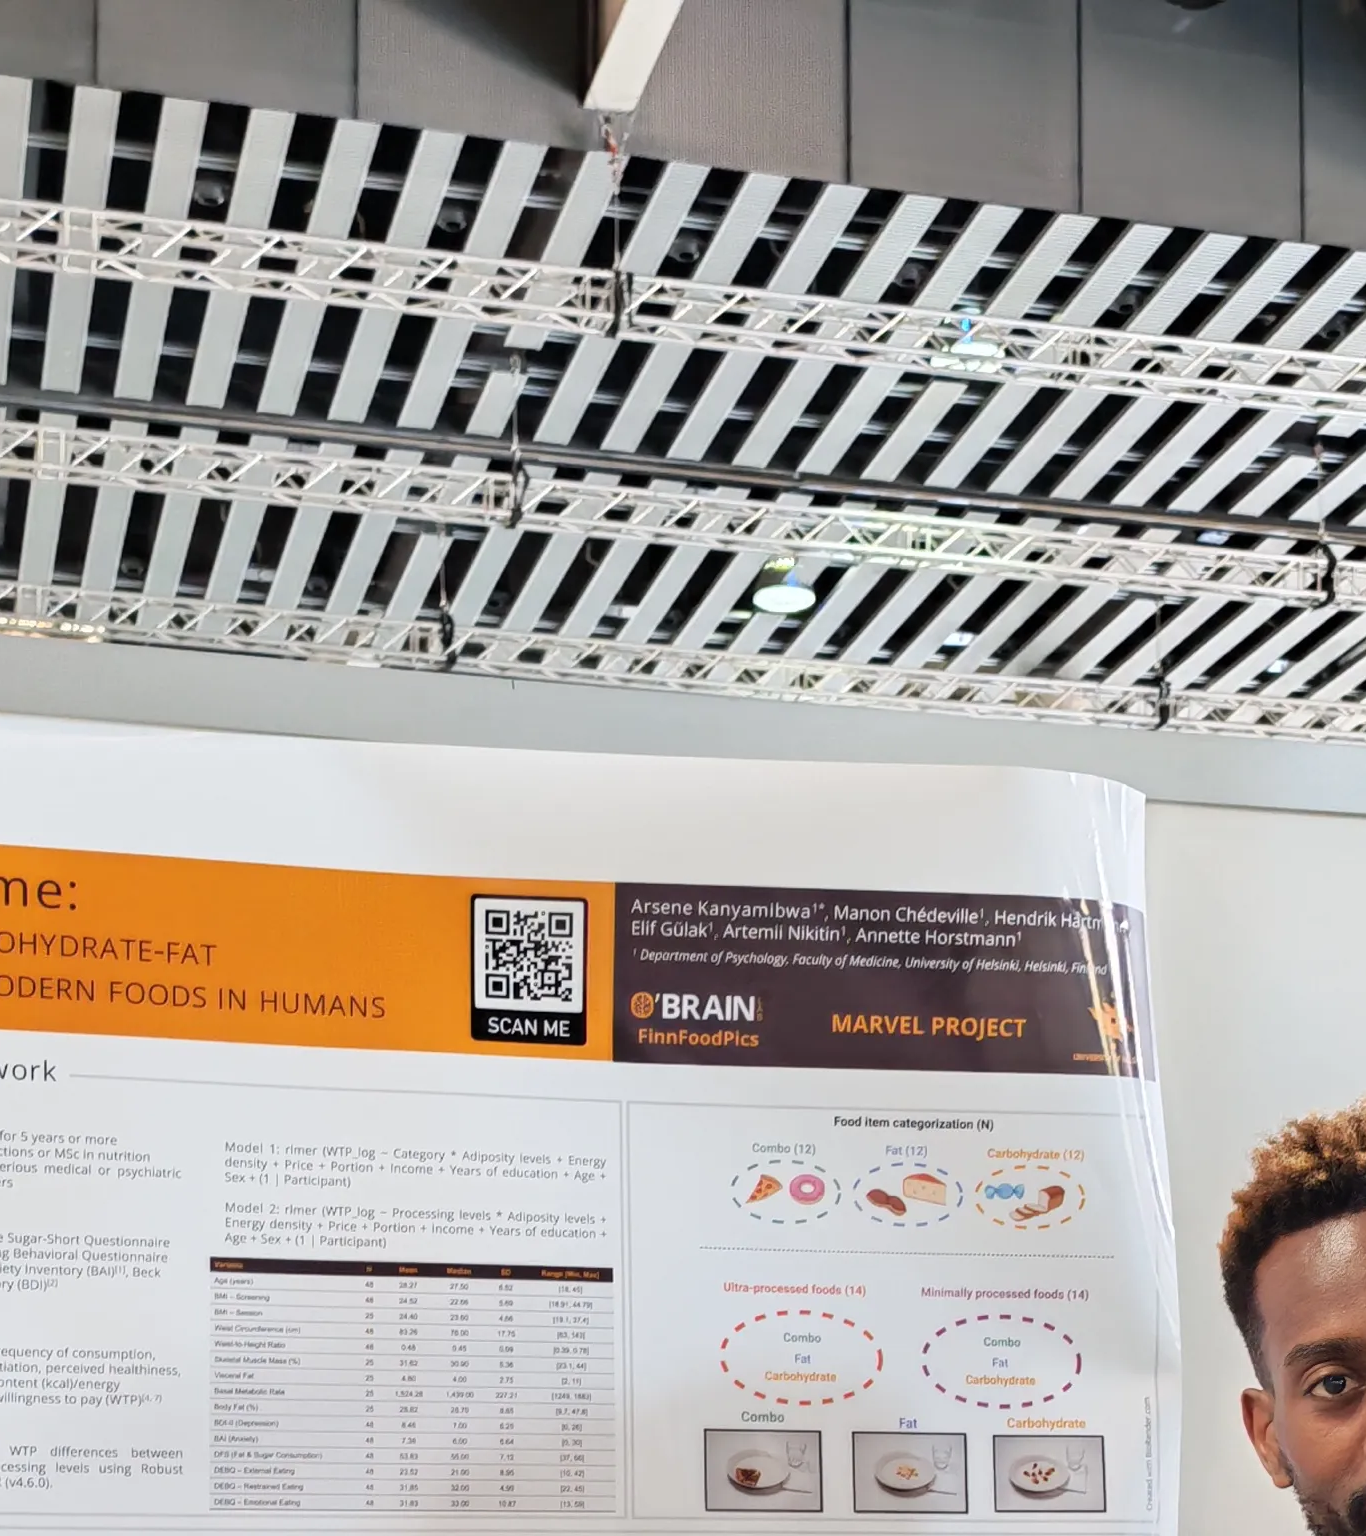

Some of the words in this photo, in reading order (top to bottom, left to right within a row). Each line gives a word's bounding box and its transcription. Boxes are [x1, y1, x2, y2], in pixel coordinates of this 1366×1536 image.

[630, 898, 693, 916] Arsene
[834, 904, 891, 922] Manon
[995, 910, 1056, 927] Hendrik
[631, 919, 658, 936] Elif
[722, 923, 783, 941] Artemii
[854, 927, 921, 945] Annette
[639, 948, 709, 964] Department
[710, 950, 725, 966] of
[724, 950, 790, 968] Psychology,
[792, 952, 834, 970] Faculty
[834, 953, 849, 970] of
[848, 955, 902, 969] Medicine,
[904, 956, 961, 973] University
[961, 957, 976, 973] of
[975, 958, 1022, 973] Helsinki,
[1025, 961, 1068, 974] Helsinki,
[110, 981, 206, 1008] FOODS
[219, 988, 245, 1010] IN
[261, 991, 385, 1018] HUMANS
[487, 1016, 534, 1036] SCAN
[538, 1019, 571, 1038] ME
[831, 1013, 925, 1035] MARVEL
[932, 1017, 1026, 1041] PROJECT
[638, 1027, 760, 1048] FinnFoodPics
[833, 1115, 862, 1127] Food
[864, 1116, 890, 1128] item
[892, 1118, 974, 1132] categorization
[976, 1119, 994, 1133] (N)
[0, 1129, 17, 1142] for
[20, 1131, 28, 1142] 5
[31, 1133, 65, 1146] years
[68, 1135, 82, 1144] or
[85, 1135, 118, 1146] more
[751, 1142, 791, 1154] Combo
[793, 1143, 816, 1157] (12)
[885, 1145, 903, 1156] Fat
[905, 1145, 928, 1159] (12)
[987, 1148, 1060, 1161] Carbohydrate
[1063, 1150, 1084, 1162] (12)
[723, 1281, 809, 1295] Ultra-processed
[811, 1283, 842, 1296] foods
[844, 1284, 867, 1298] (14)
[921, 1286, 974, 1301] Minimally
[975, 1288, 1031, 1301] processed
[1034, 1289, 1064, 1299] foods
[1067, 1290, 1088, 1301] (14)
[783, 1331, 822, 1344] Combo
[794, 1353, 811, 1365] Fat
[764, 1371, 837, 1384] Carbohydrate
[740, 1410, 785, 1423] Combo
[898, 1417, 918, 1429] Fat
[1007, 1417, 1085, 1430] Carbohydrate
